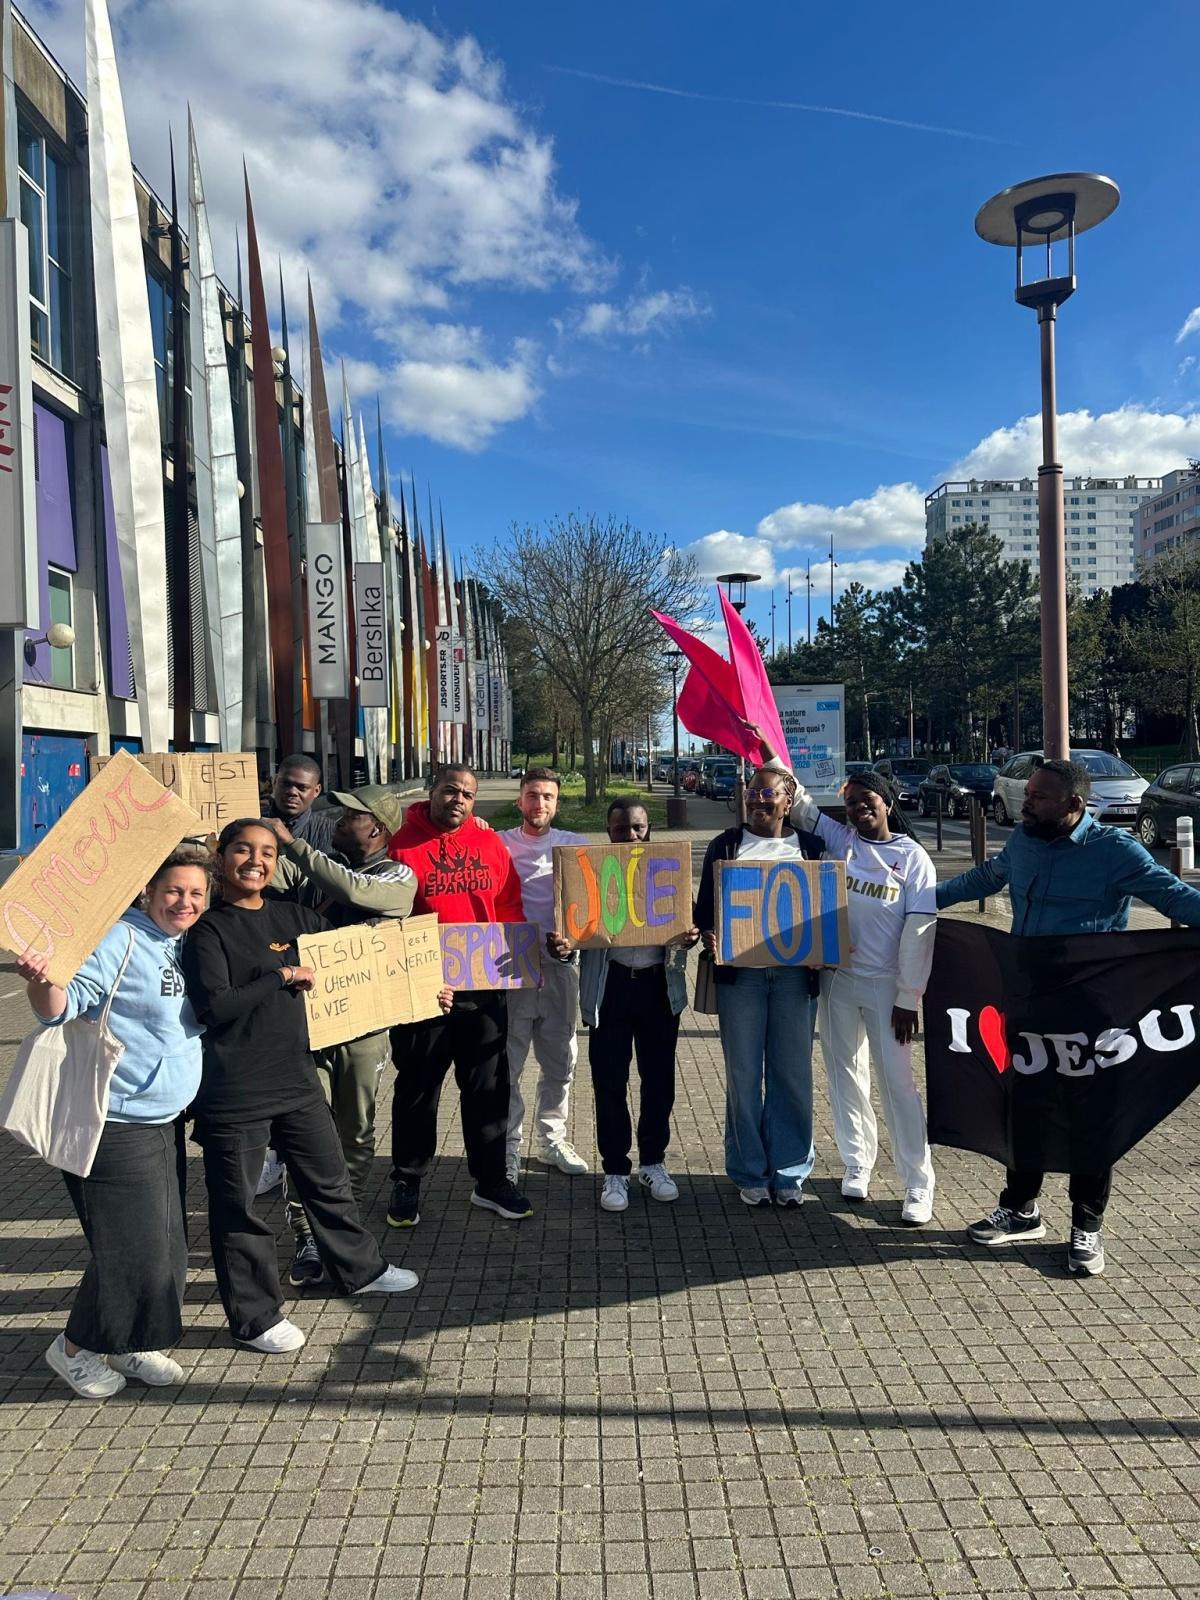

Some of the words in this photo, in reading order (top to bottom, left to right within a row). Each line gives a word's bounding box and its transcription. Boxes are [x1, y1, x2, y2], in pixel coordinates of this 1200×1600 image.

[314, 553, 337, 664] MANGO
[360, 586, 383, 680] Bershka
[436, 631, 450, 641] JD
[439, 649, 448, 708] JDSPORTS.FR
[201, 760, 249, 784] EST
[200, 795, 229, 821] ITÉ
[3, 765, 176, 961] amour
[847, 876, 899, 901] OLIMIT
[301, 934, 387, 973] JESUS
[408, 931, 428, 947] est
[440, 924, 541, 990] SPOIR
[324, 970, 371, 993] CHEMIN
[386, 964, 396, 977] la
[310, 1003, 320, 1021] la
[324, 997, 350, 1016] VIE
[946, 1008, 972, 1053] I
[1012, 1004, 1195, 1076] JESU
